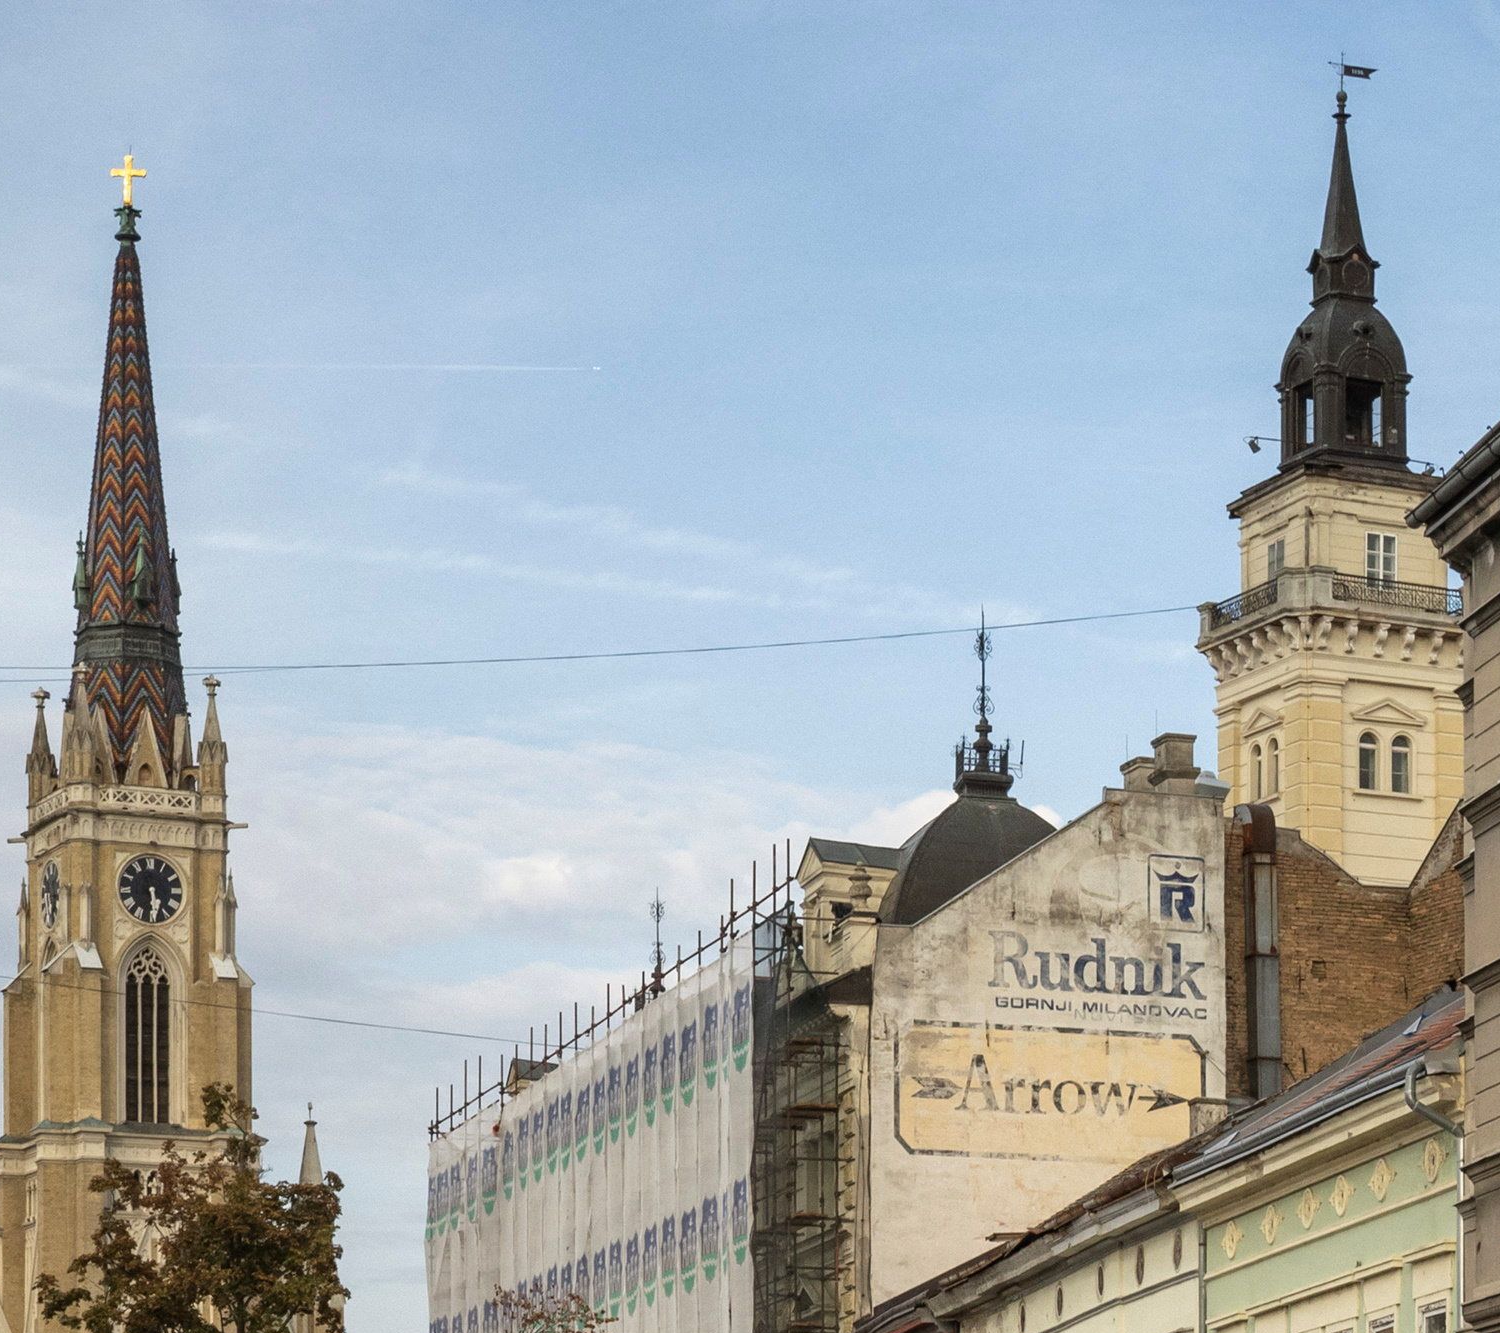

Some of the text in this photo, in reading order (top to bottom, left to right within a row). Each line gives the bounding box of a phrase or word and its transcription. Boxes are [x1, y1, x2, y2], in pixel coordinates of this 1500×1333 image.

[987, 930, 1208, 1001] Rudnik
[995, 996, 1208, 1020] GORNJI MILANOVAC
[956, 1053, 1143, 1118] Arrow
